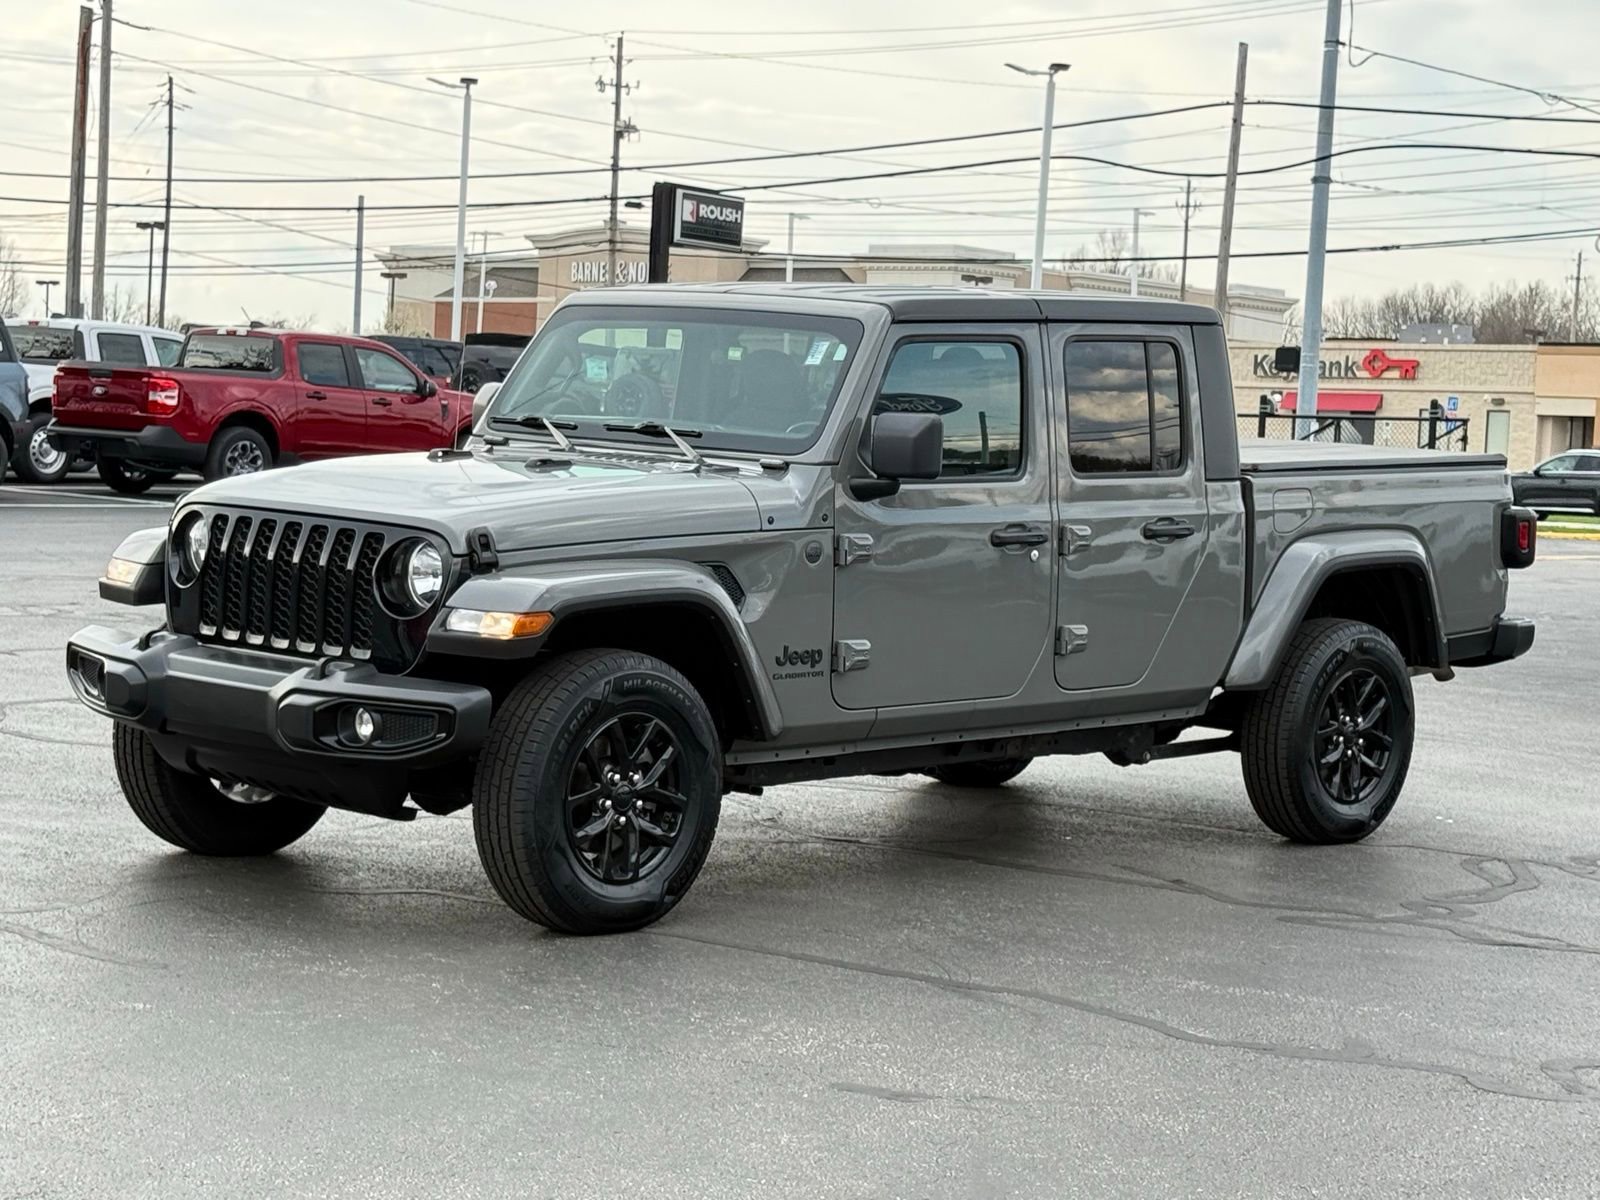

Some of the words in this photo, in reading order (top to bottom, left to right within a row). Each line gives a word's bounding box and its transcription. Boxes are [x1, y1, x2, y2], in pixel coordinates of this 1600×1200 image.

[699, 203, 742, 223] ROUSH
[615, 260, 627, 282] &
[1253, 354, 1358, 382] Keank
[775, 645, 823, 668] Jeep
[773, 670, 824, 681] GLADIATOR
